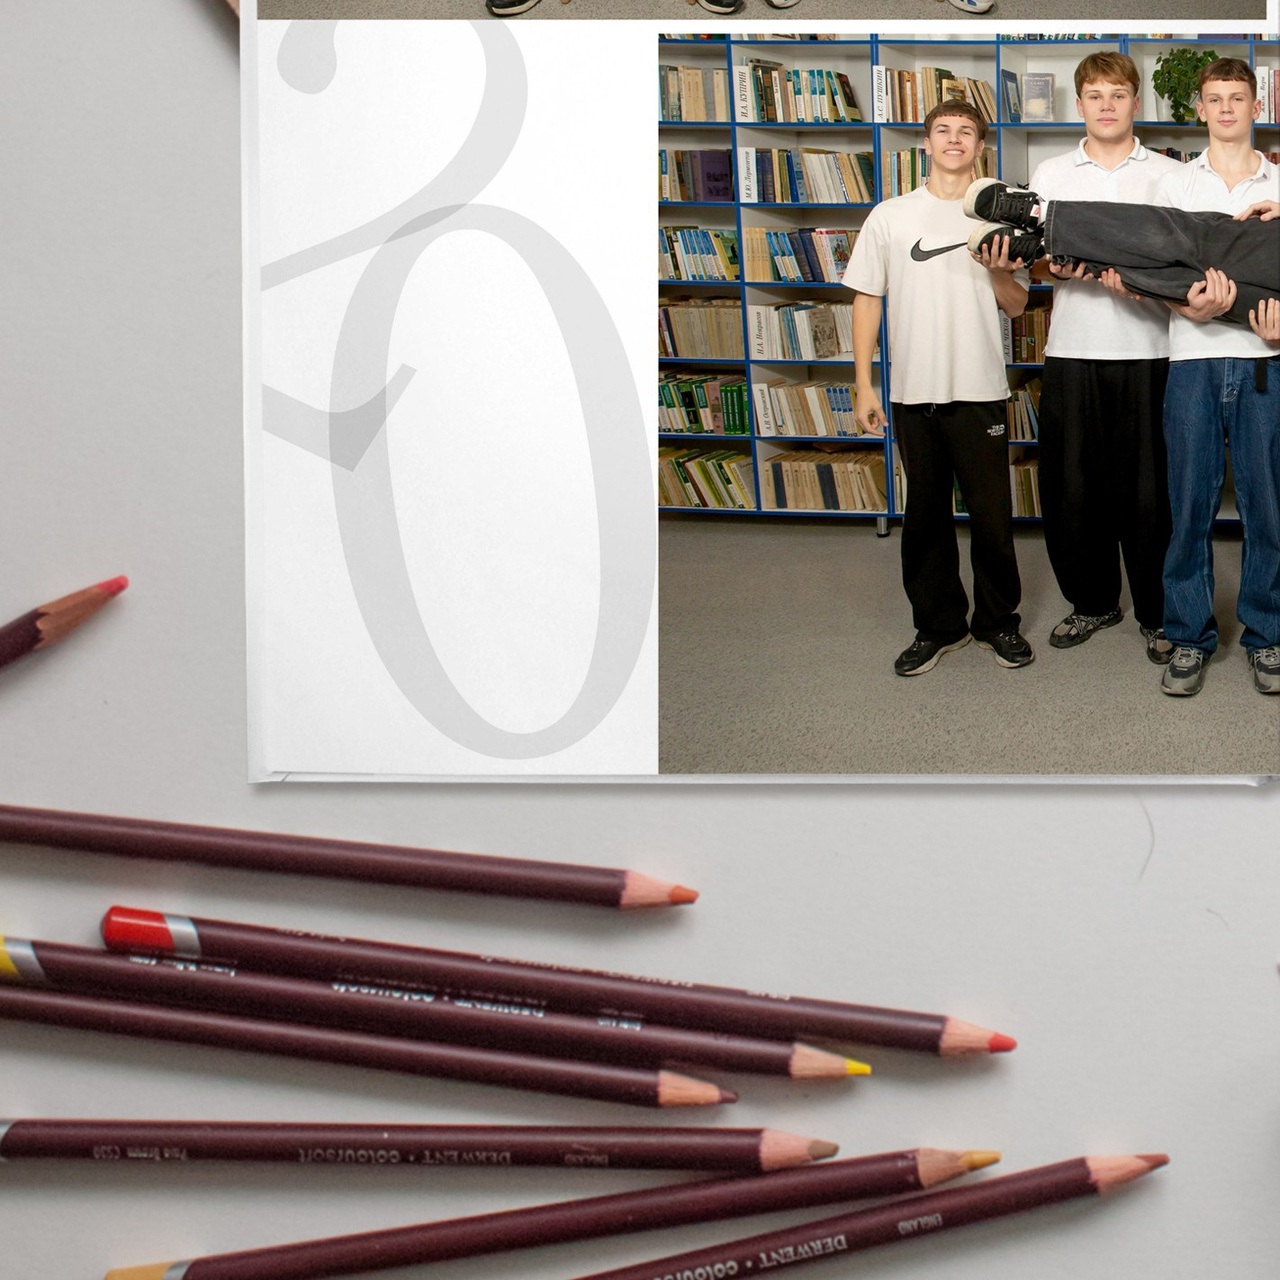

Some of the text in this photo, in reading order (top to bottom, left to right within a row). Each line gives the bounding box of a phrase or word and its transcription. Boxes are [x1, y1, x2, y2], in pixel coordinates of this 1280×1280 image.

[739, 71, 749, 118] И.А. КУПРИН
[744, 151, 752, 183] Лермонтов
[756, 312, 764, 340] Некрасов
[760, 388, 771, 419] Островский
[298, 1147, 512, 1164] DERWENT coloursoft
[897, 1213, 943, 1234] ENGLAND
[758, 1233, 848, 1269] DERWENT
